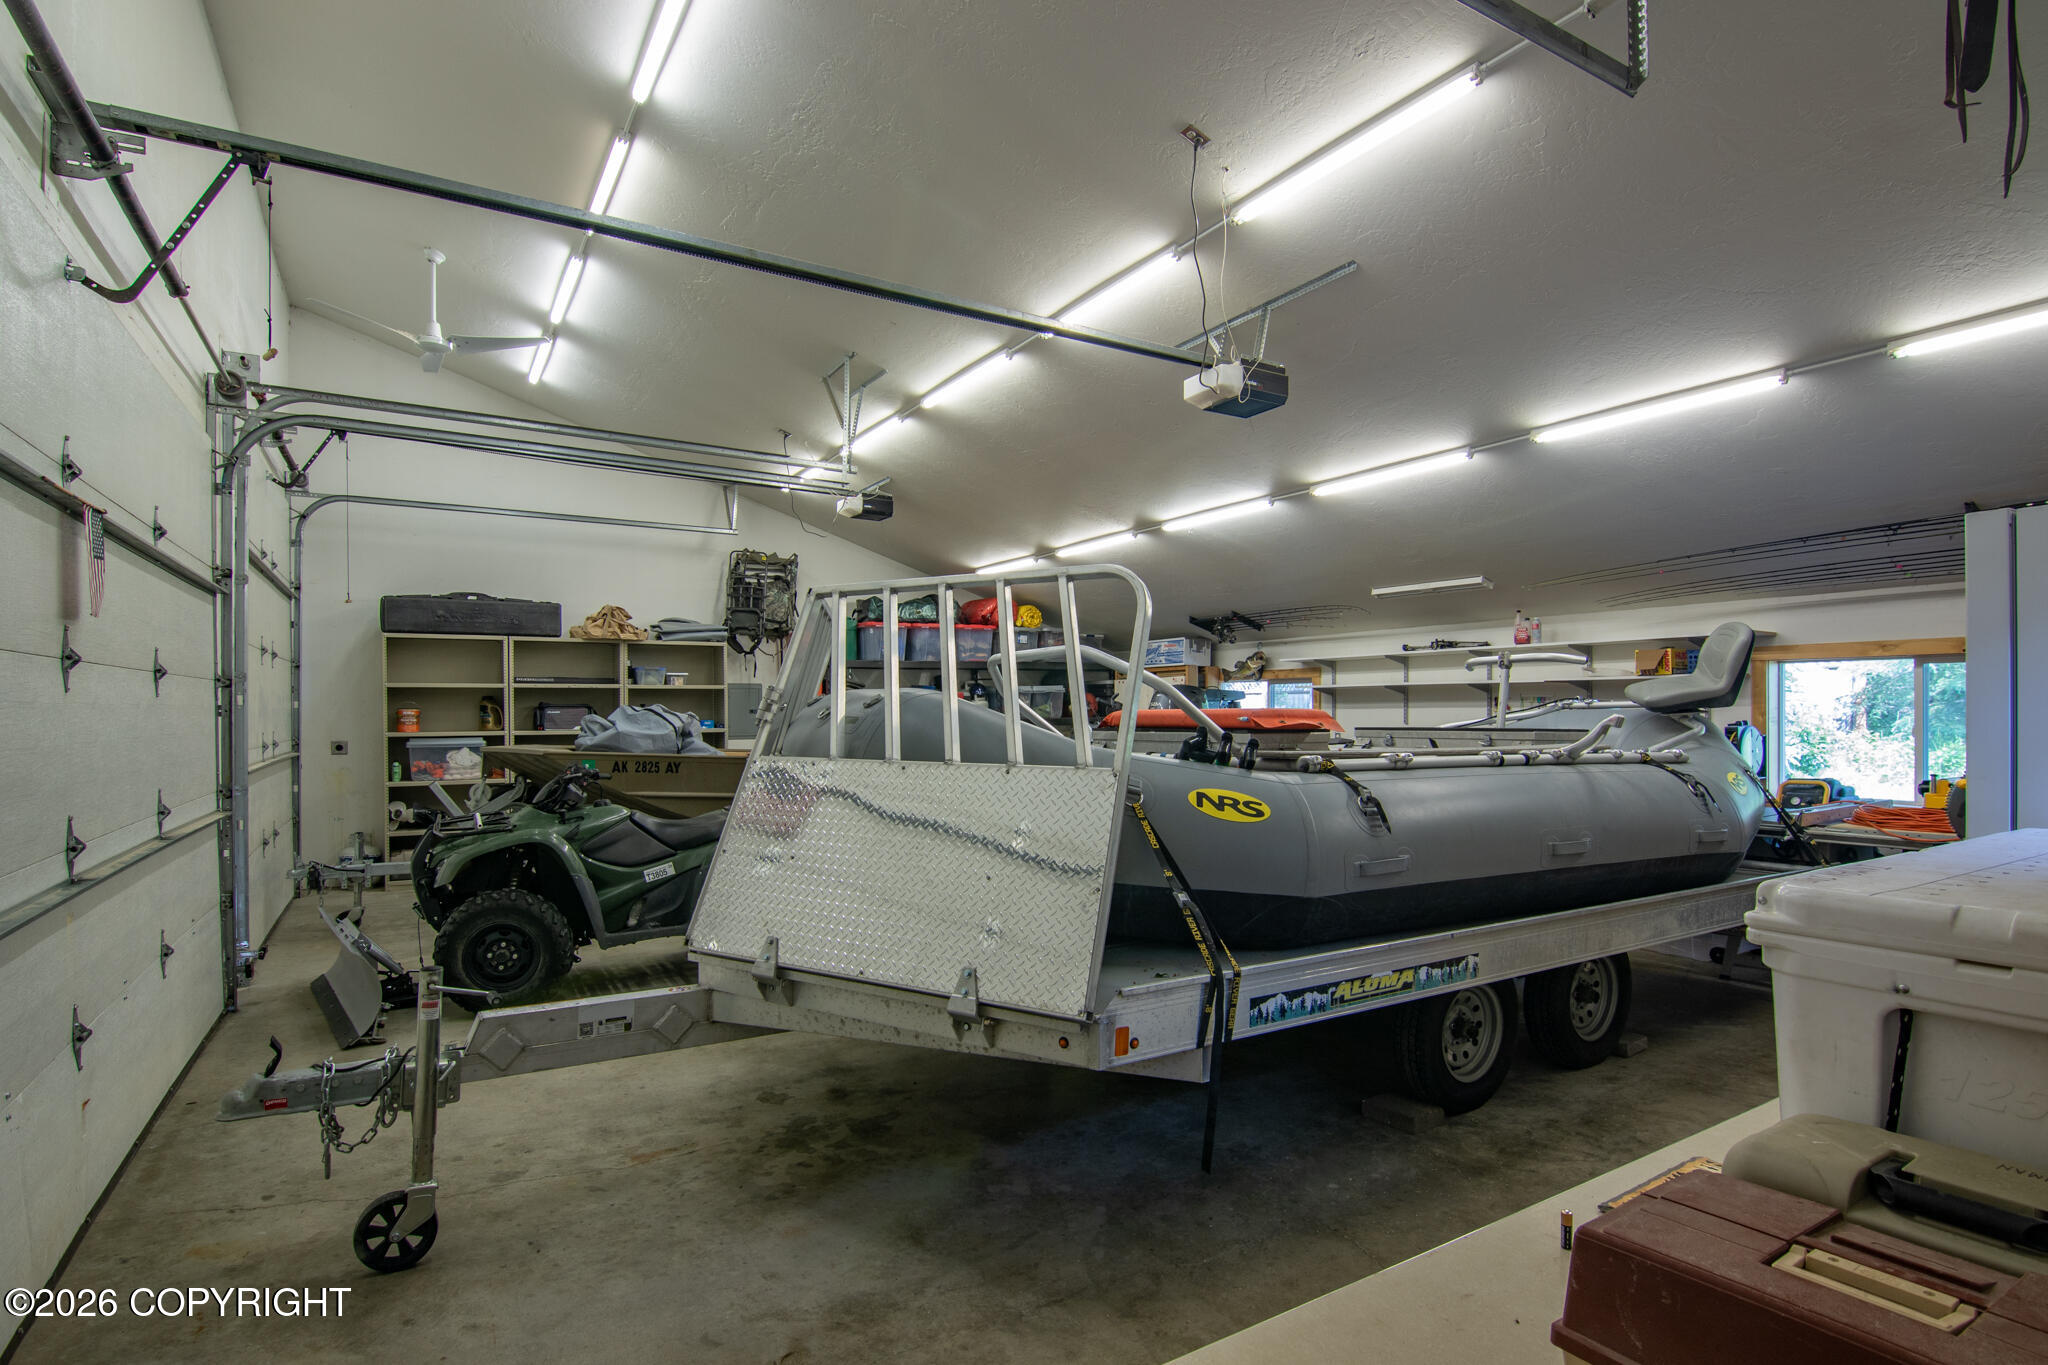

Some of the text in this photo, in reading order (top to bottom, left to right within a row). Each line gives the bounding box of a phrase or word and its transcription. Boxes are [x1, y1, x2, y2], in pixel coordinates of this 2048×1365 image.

[612, 761, 681, 774] AK 2825 AY
[1195, 791, 1265, 818] NRS
[1141, 820, 1159, 848] CASCADE
[1186, 917, 1203, 941] RIVER
[1231, 976, 1241, 1003] RIVER
[1334, 968, 1415, 999] ALUMA
